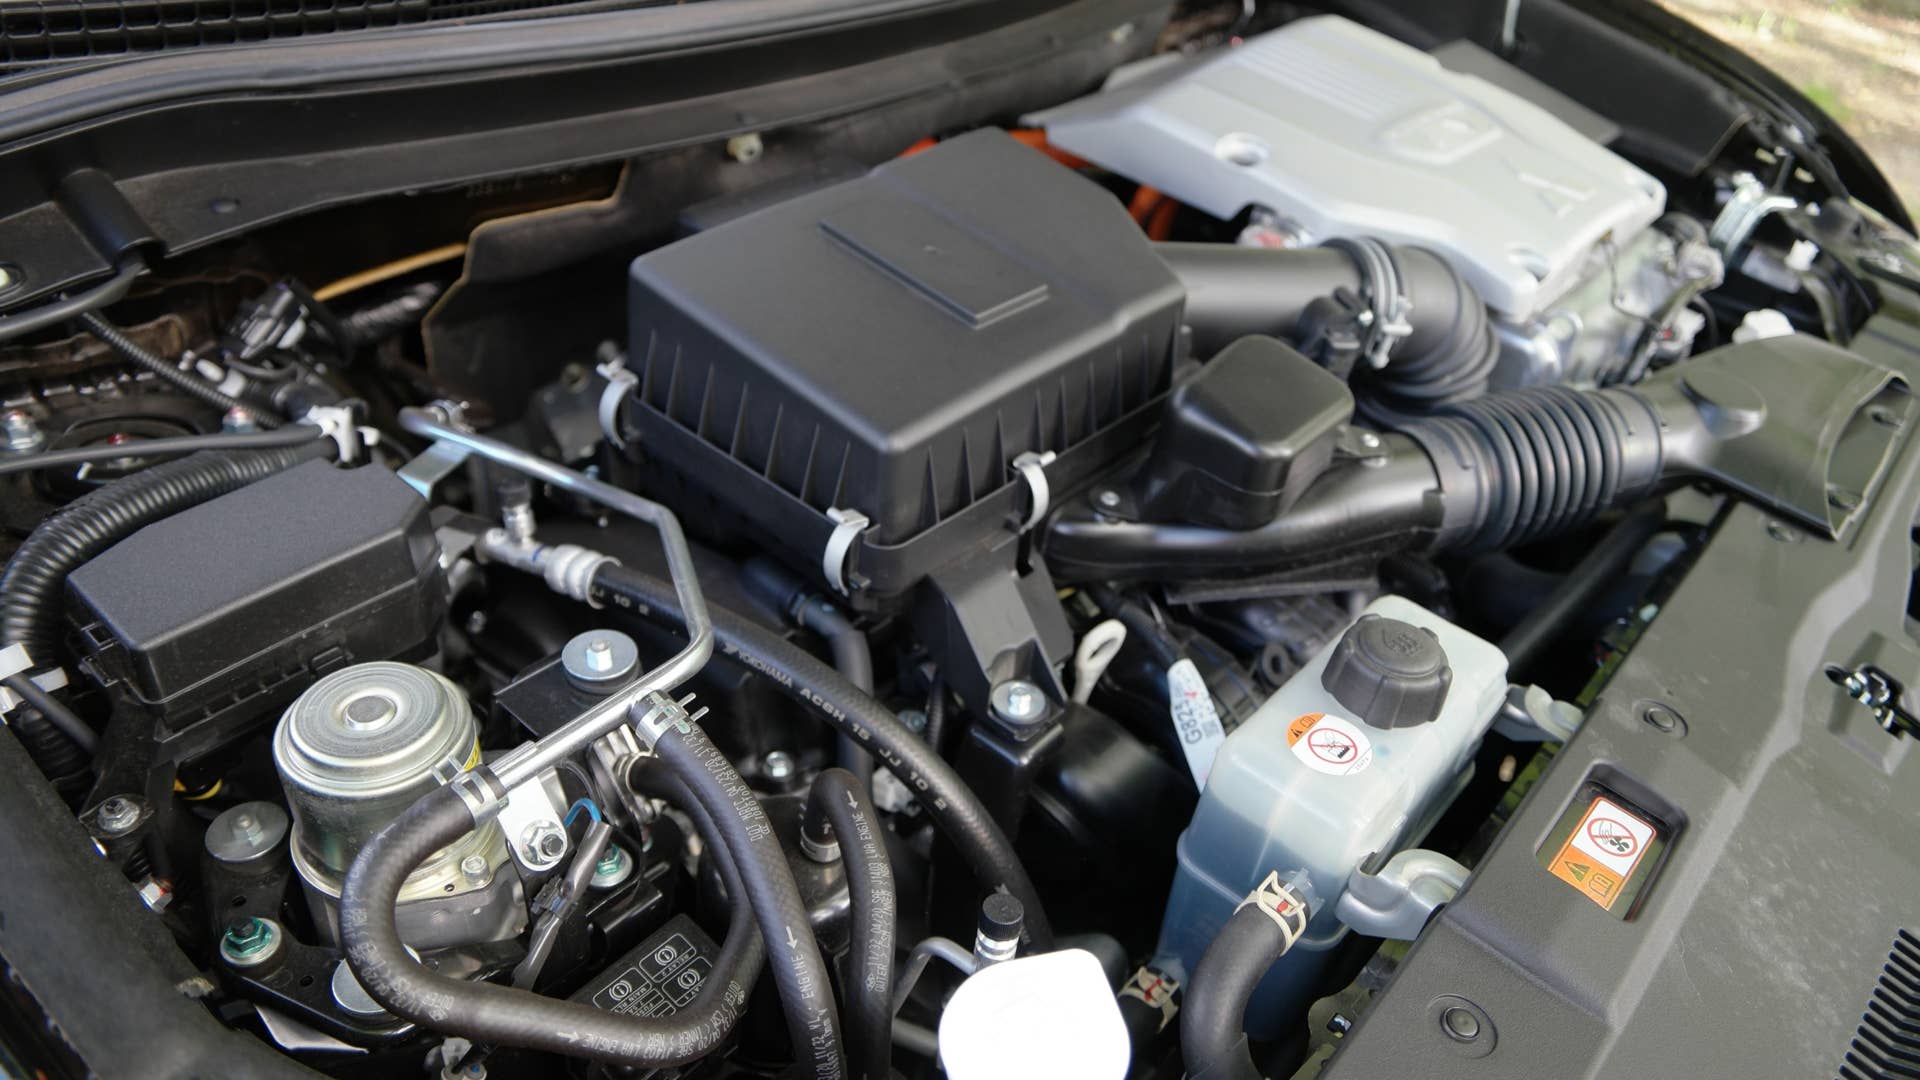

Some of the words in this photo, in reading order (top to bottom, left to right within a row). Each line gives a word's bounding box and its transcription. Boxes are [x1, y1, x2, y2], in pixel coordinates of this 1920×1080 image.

[739, 650, 793, 688] YOKOHAMA
[910, 771, 928, 791] 10
[852, 811, 872, 841] ENGINE
[791, 954, 815, 1000] ENGINE
